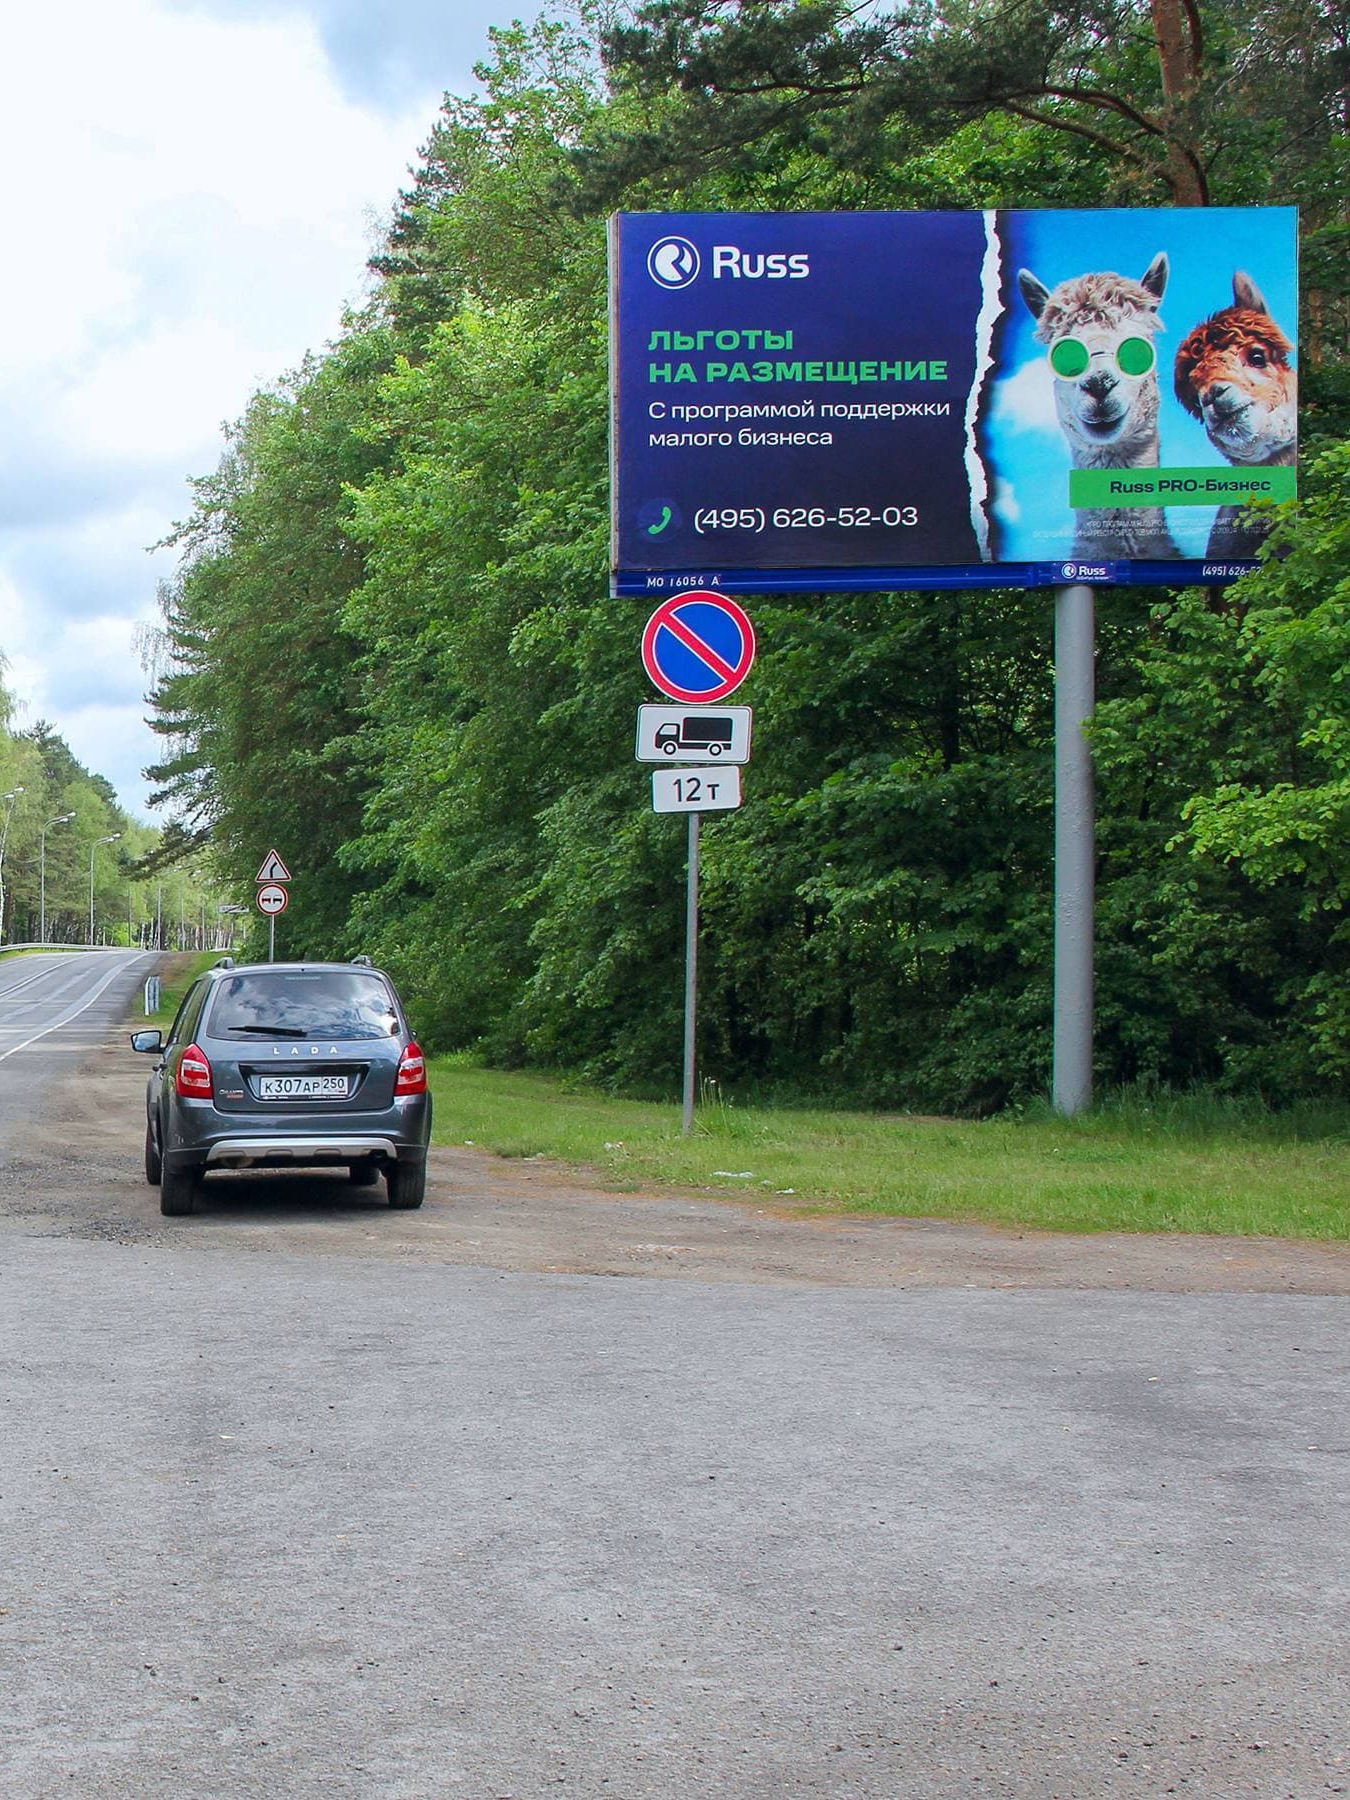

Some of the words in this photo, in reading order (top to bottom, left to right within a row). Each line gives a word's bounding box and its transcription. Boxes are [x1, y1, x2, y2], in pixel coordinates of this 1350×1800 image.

[713, 246, 810, 279] Russ
[648, 330, 793, 351] ЛЬГОТЫ
[649, 363, 697, 383] НА
[706, 360, 948, 385] РАЗМЕЩЕНИЕ
[649, 402, 666, 419] С
[671, 400, 815, 423] программой
[821, 402, 950, 421] поддержки
[649, 433, 732, 447] малого
[738, 428, 833, 446] бизнеса
[1110, 481, 1154, 494] Russ
[1158, 479, 1271, 493] PRO-Бизнес
[694, 508, 765, 534] (495)
[772, 506, 919, 528] 626-52-03
[1079, 566, 1106, 576] Russ
[1202, 565, 1227, 576] (495)
[670, 576, 704, 587] 16056
[673, 778, 701, 802] 12
[273, 1046, 338, 1055] LADA
[323, 1078, 344, 1089] 250
